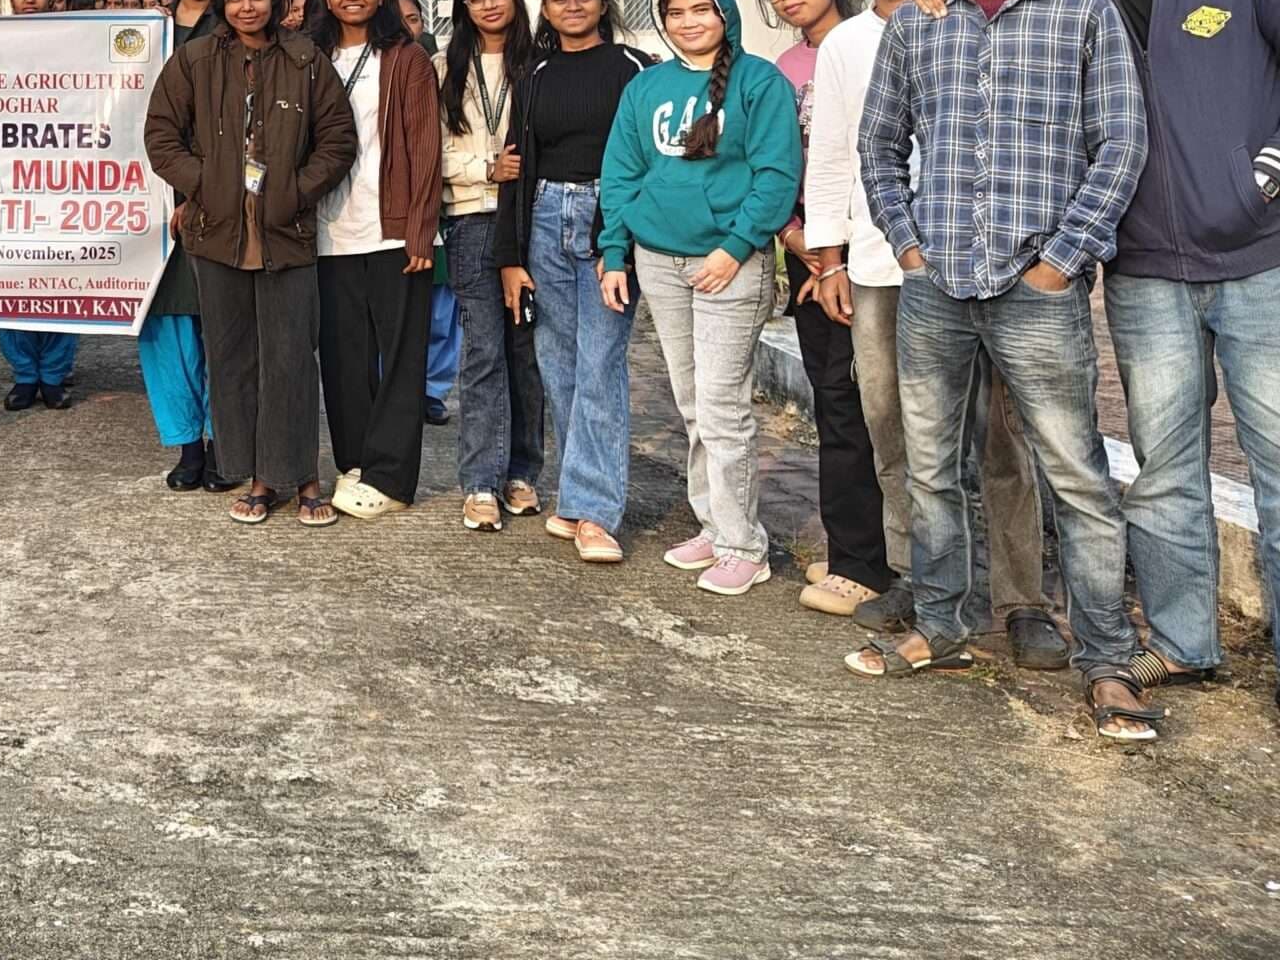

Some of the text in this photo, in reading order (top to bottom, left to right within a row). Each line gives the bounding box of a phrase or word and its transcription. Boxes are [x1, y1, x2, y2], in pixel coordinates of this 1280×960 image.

[12, 73, 145, 90] AGRICULTURE
[12, 160, 147, 192] MUNDA
[60, 200, 148, 232] 2025
[79, 246, 117, 261] 2025
[28, 277, 83, 291] RNTAC,
